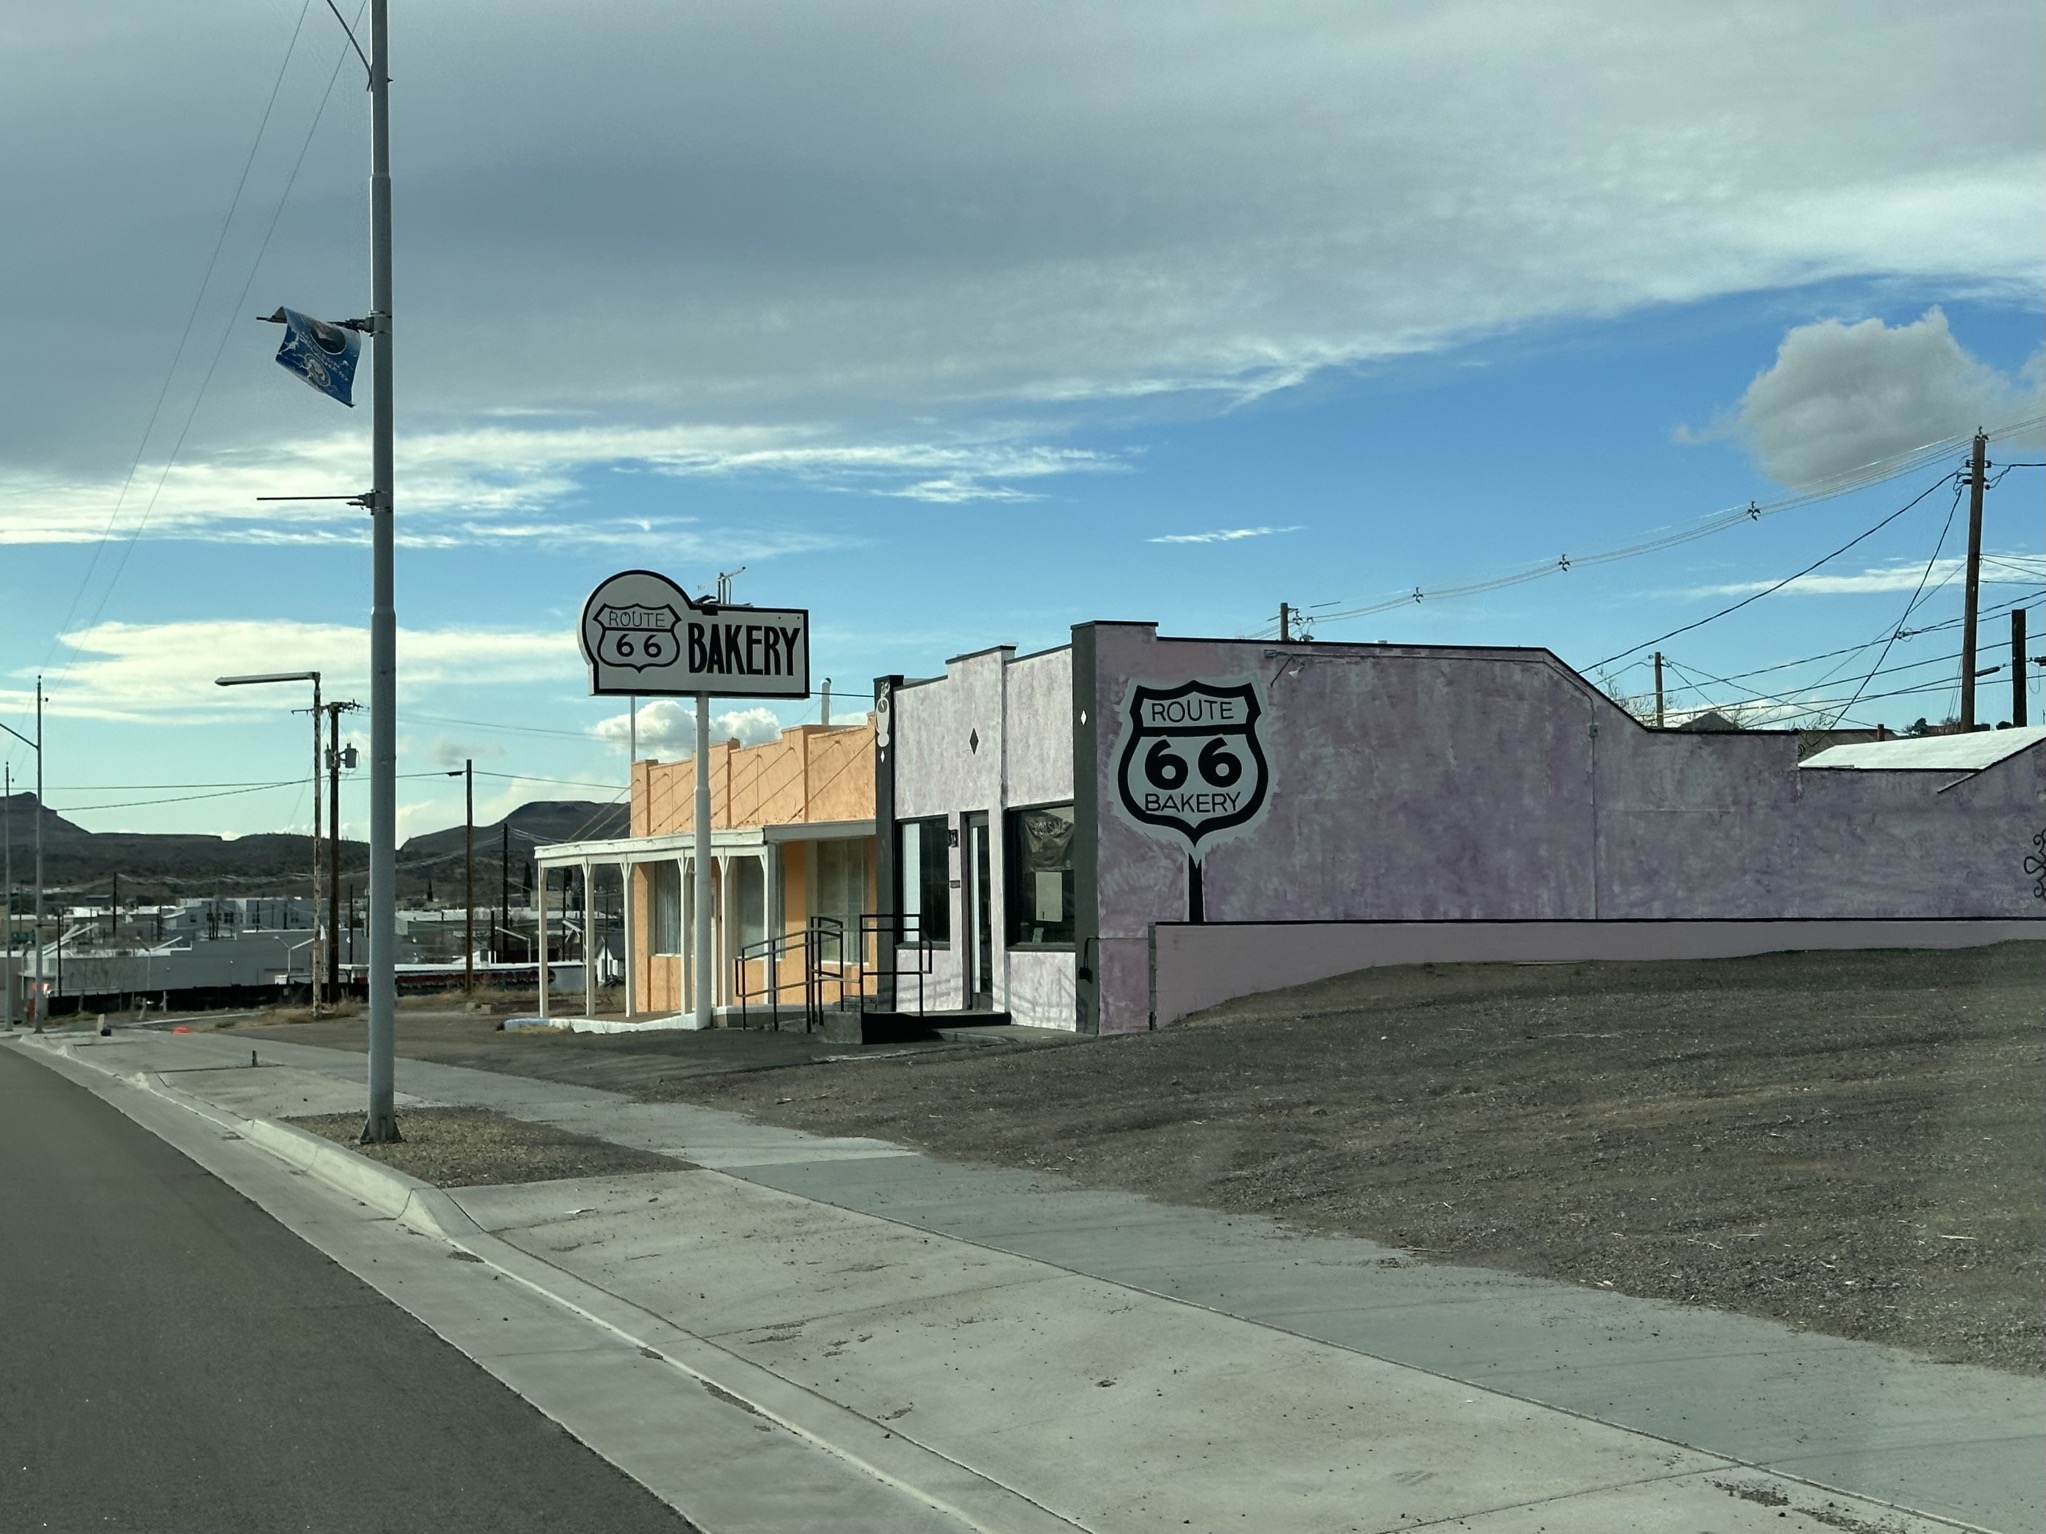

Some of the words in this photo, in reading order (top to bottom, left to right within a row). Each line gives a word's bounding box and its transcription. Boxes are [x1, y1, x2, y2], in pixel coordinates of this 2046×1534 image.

[608, 610, 666, 628] ROUTE
[616, 633, 662, 658] 66
[688, 622, 801, 676] BAKERY
[1151, 699, 1234, 723] ROUTE
[1144, 737, 1242, 790] 66
[1145, 791, 1241, 813] BAKERY
